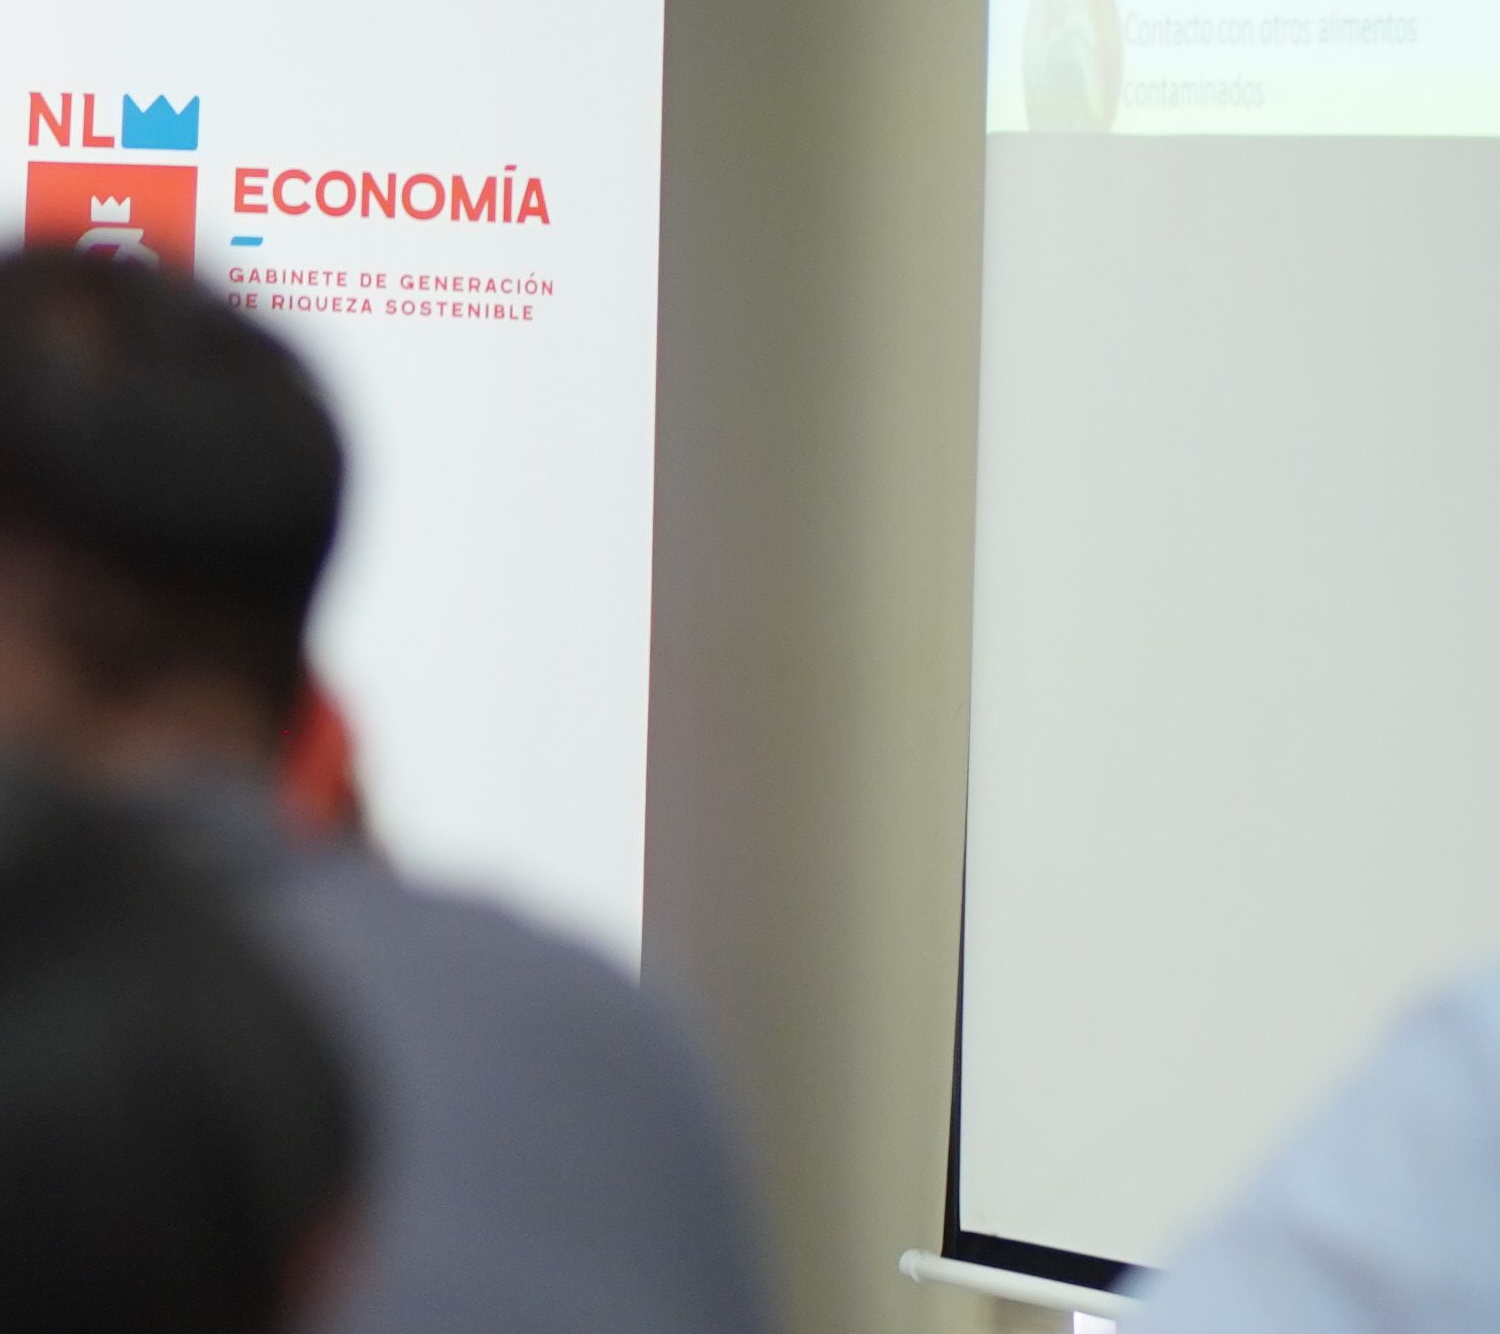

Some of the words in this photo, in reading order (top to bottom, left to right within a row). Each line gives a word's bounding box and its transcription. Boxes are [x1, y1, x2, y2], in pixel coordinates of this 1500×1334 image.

[1124, 13, 1213, 48] Contacto
[1217, 19, 1254, 46] con
[1123, 71, 1265, 109] contaminados
[28, 92, 115, 149] NL
[233, 165, 551, 225] ECONOMÍA
[229, 267, 349, 288] GABINETE
[360, 272, 387, 289] DE
[399, 272, 555, 296] GENERACIÓN
[228, 293, 260, 311] DE
[271, 295, 374, 316] RIQUEZA
[386, 300, 534, 321] SOSTENIBLE
